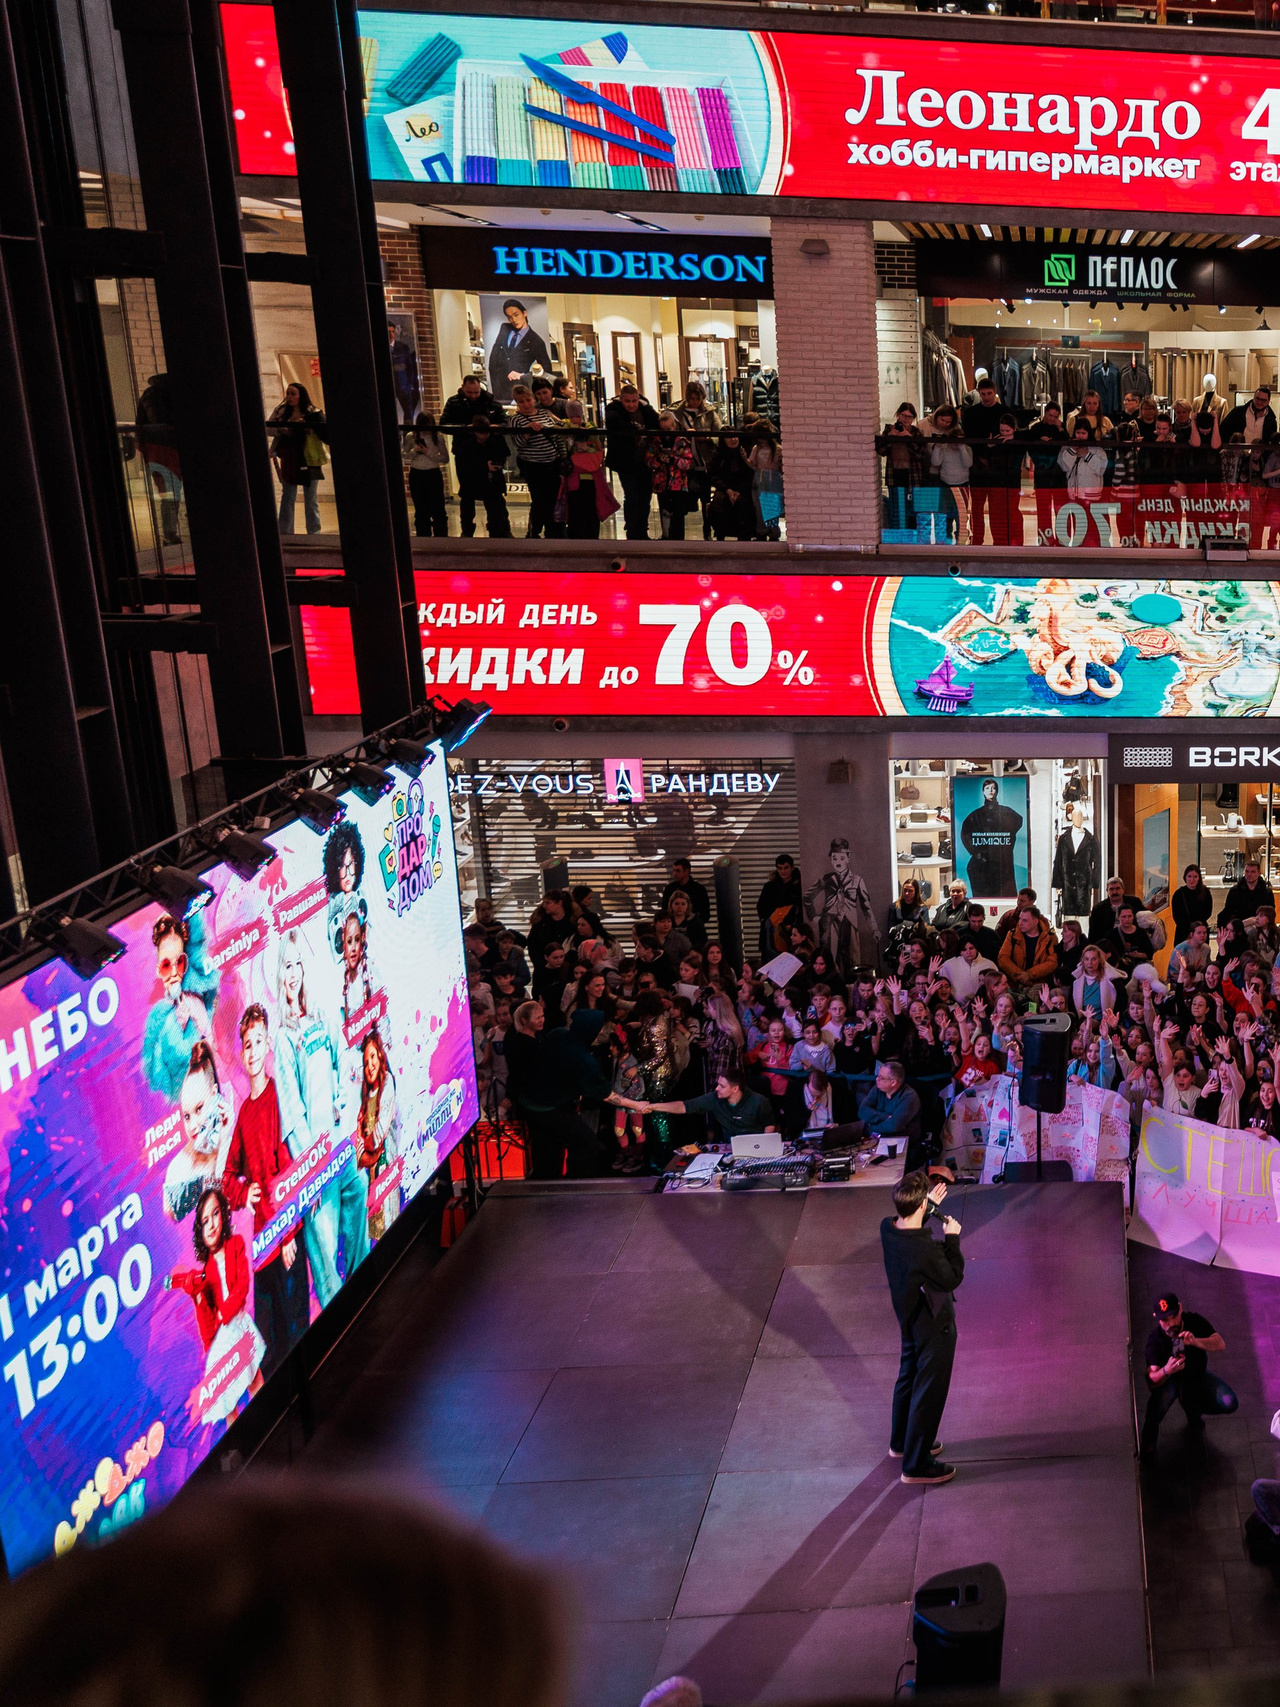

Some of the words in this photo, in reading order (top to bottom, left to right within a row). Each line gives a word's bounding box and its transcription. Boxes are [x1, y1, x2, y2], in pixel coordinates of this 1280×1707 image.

[844, 68, 1202, 151] Леонардо
[847, 138, 1201, 184] хобби-гипермаркет
[493, 246, 766, 284] HENDERSON
[1117, 290, 1162, 298] ШКОЛЬНАЯ
[1166, 291, 1197, 299] ФОРМА
[518, 603, 598, 629] ДЕНЬ
[600, 665, 639, 690] до
[650, 772, 780, 796] РАНДЕВУ
[397, 811, 423, 847] ПРО
[972, 837, 1011, 847] LUMIQUE
[398, 833, 427, 883] ДАР
[398, 860, 433, 917] ДОМ
[0, 976, 120, 1094] НЕБО
[144, 1110, 181, 1149] Леди
[147, 1131, 182, 1169] Леся
[251, 1203, 296, 1259] Макар
[297, 1143, 353, 1214] Давыдов
[24, 1192, 144, 1319] марта
[3, 1243, 152, 1421] 13:00
